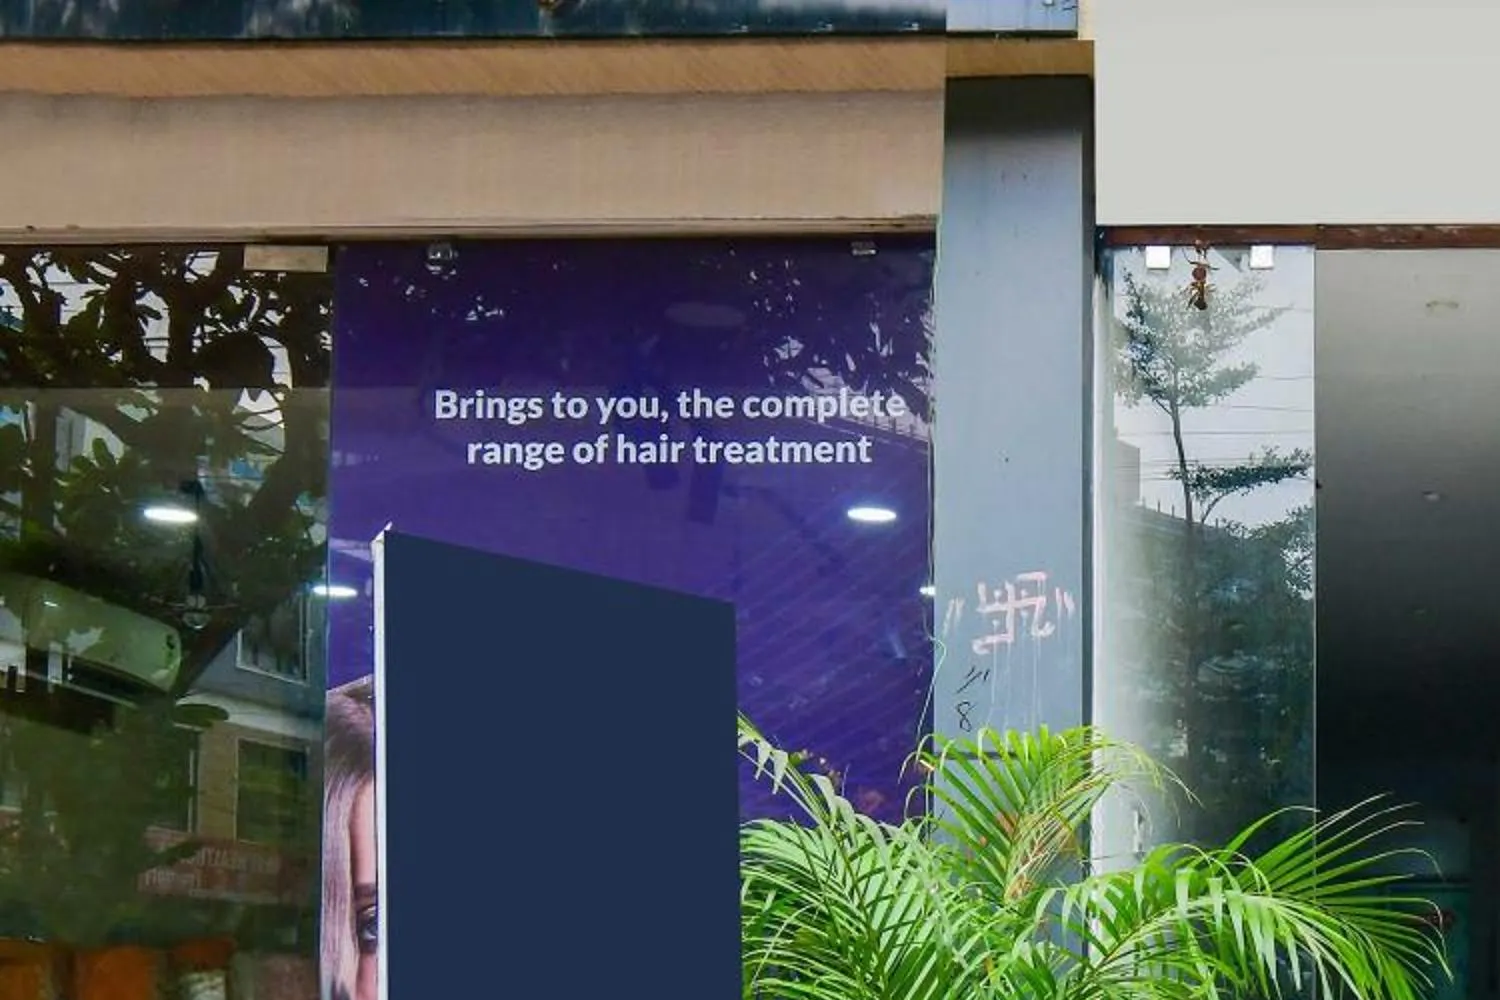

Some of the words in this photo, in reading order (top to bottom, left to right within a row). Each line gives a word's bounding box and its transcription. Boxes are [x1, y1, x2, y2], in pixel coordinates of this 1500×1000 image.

[435, 389, 544, 425] Brings
[551, 391, 589, 419] to
[596, 396, 669, 425] you,
[677, 387, 735, 418] the
[743, 387, 906, 423] complete
[467, 441, 566, 471] range
[572, 433, 609, 464] of
[617, 433, 685, 464] hair
[692, 435, 873, 464] treatment
